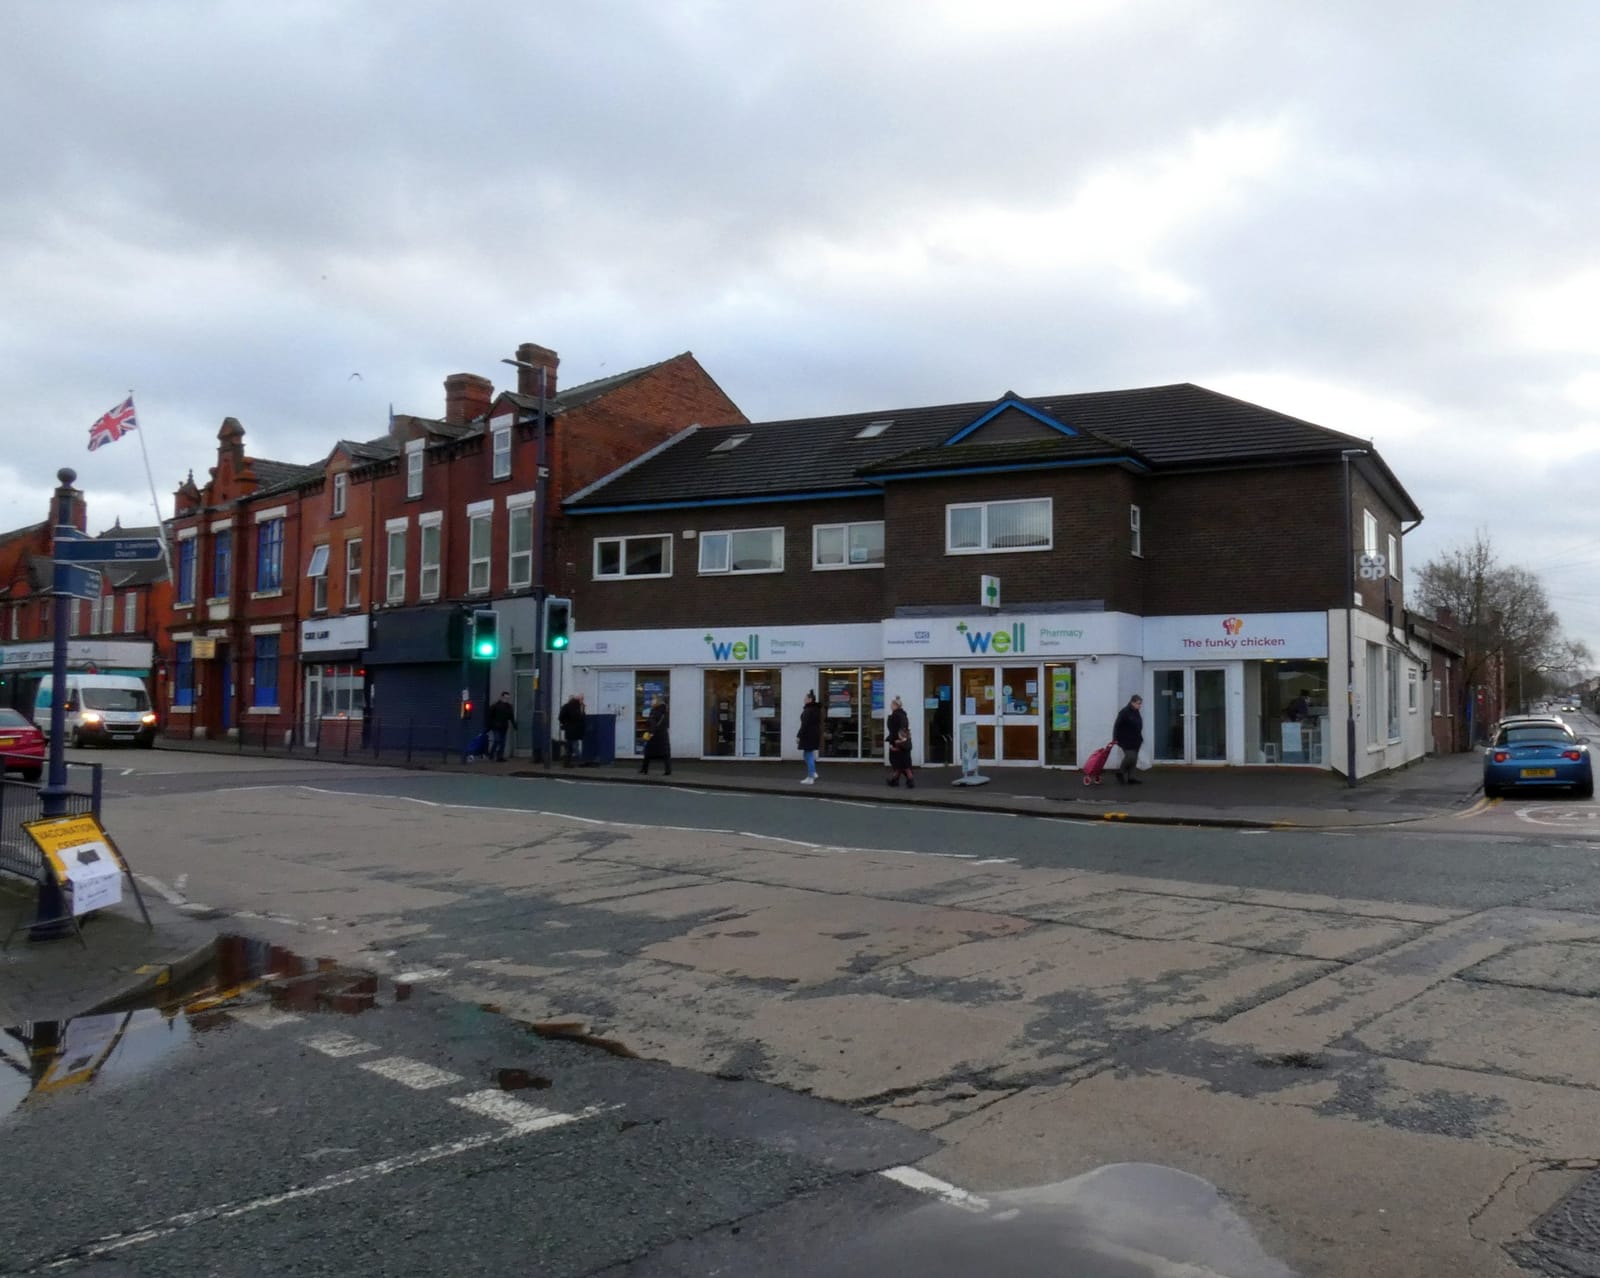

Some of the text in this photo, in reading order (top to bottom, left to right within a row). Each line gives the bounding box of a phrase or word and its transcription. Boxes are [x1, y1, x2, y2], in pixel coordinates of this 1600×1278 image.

[966, 622, 1025, 653] well
[1039, 628, 1084, 639] Pharmacy
[712, 634, 759, 661] well
[770, 639, 805, 648] Pharmacy
[1183, 637, 1286, 649] The funky chicken
